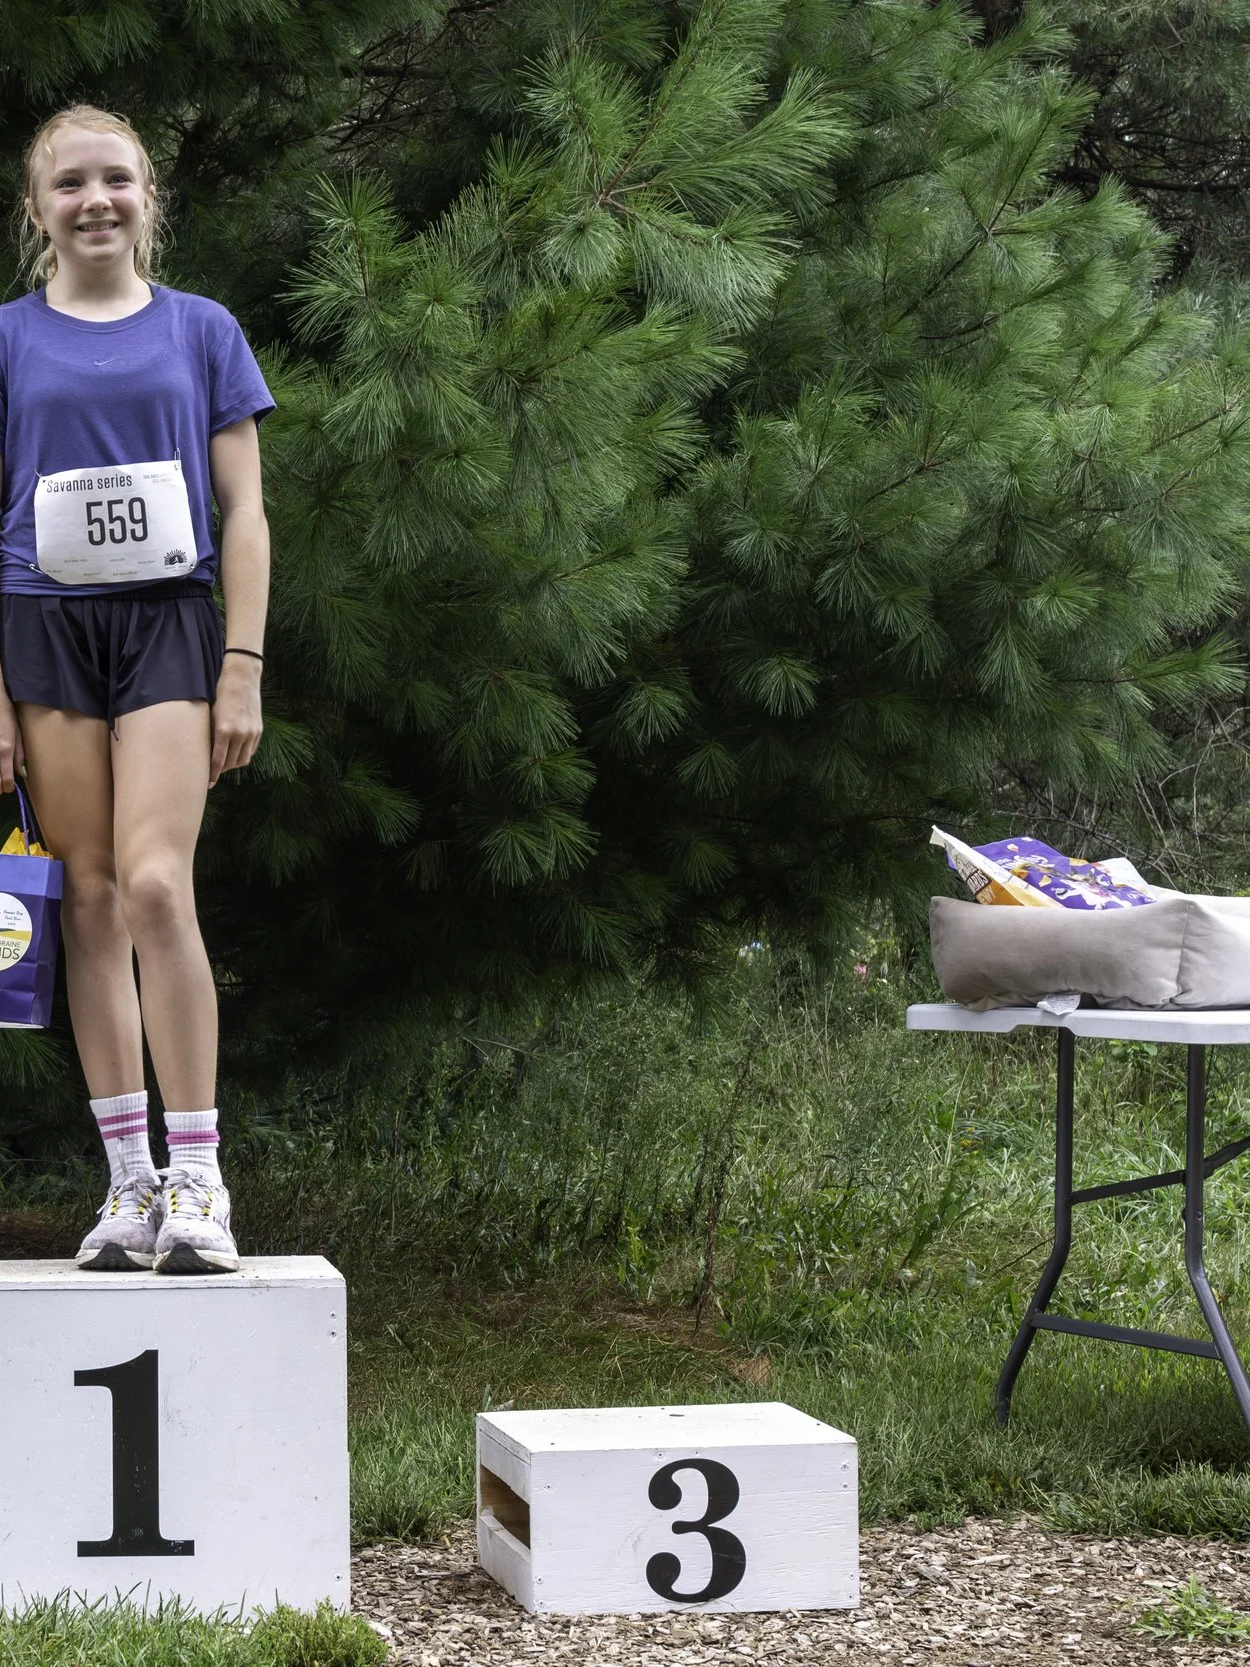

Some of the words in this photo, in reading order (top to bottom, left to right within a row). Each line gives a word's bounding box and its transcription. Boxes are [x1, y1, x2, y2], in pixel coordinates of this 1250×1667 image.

[46, 478, 94, 493] Savanna
[97, 474, 133, 490] series
[85, 496, 149, 546] 559
[74, 1348, 195, 1557] 1
[646, 1458, 746, 1603] 3
